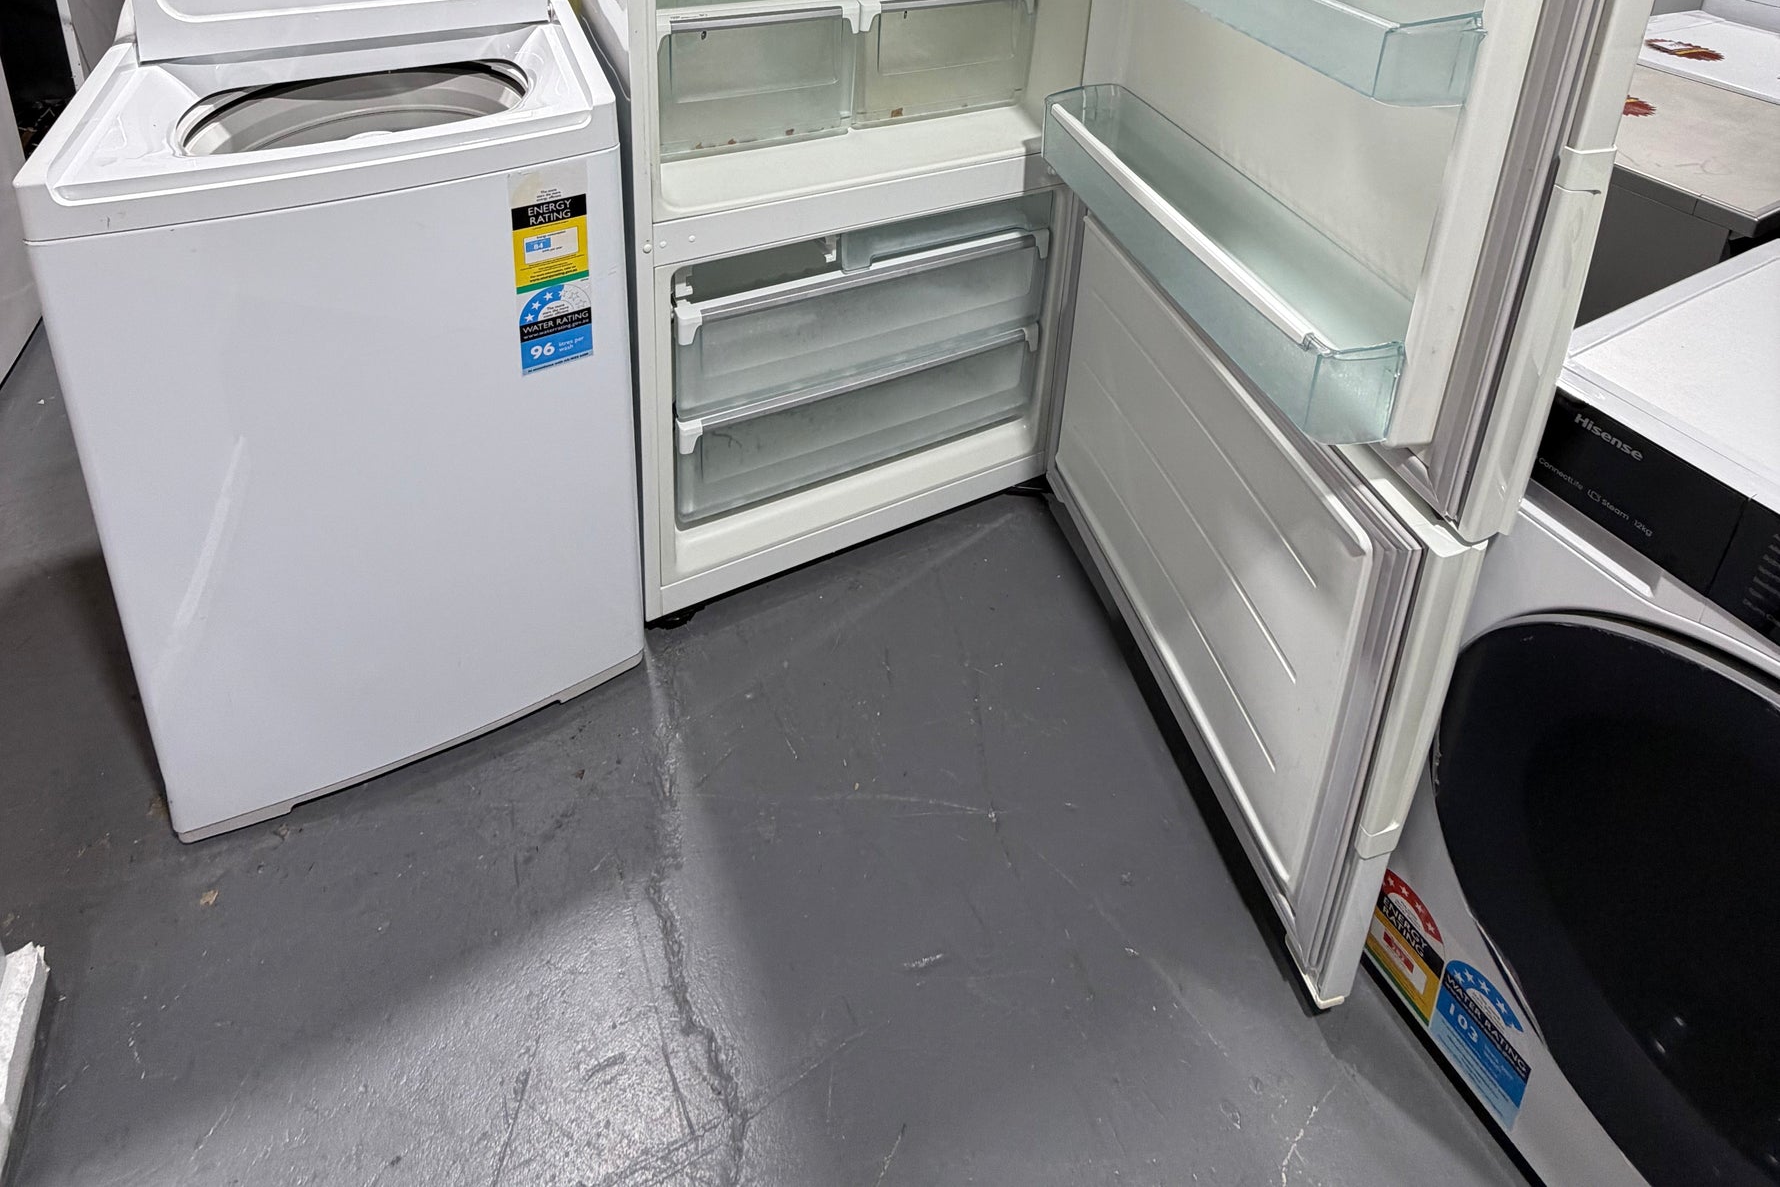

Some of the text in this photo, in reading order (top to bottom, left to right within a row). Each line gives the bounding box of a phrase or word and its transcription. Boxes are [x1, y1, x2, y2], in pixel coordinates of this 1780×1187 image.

[528, 199, 572, 216] ENERGY
[529, 209, 571, 226] RATING
[522, 310, 589, 334] WATER RATING
[530, 342, 556, 360] 96
[559, 344, 574, 352] wash
[574, 336, 585, 344] per
[1574, 413, 1643, 462] Hisense
[1601, 498, 1630, 521] Steam
[1633, 519, 1653, 537] 12kg
[1382, 905, 1425, 957] RATING
[1383, 896, 1428, 948] ENERGY
[1446, 974, 1481, 1019] WATER
[1484, 1019, 1527, 1072] RATING
[1449, 1002, 1479, 1043] 103
